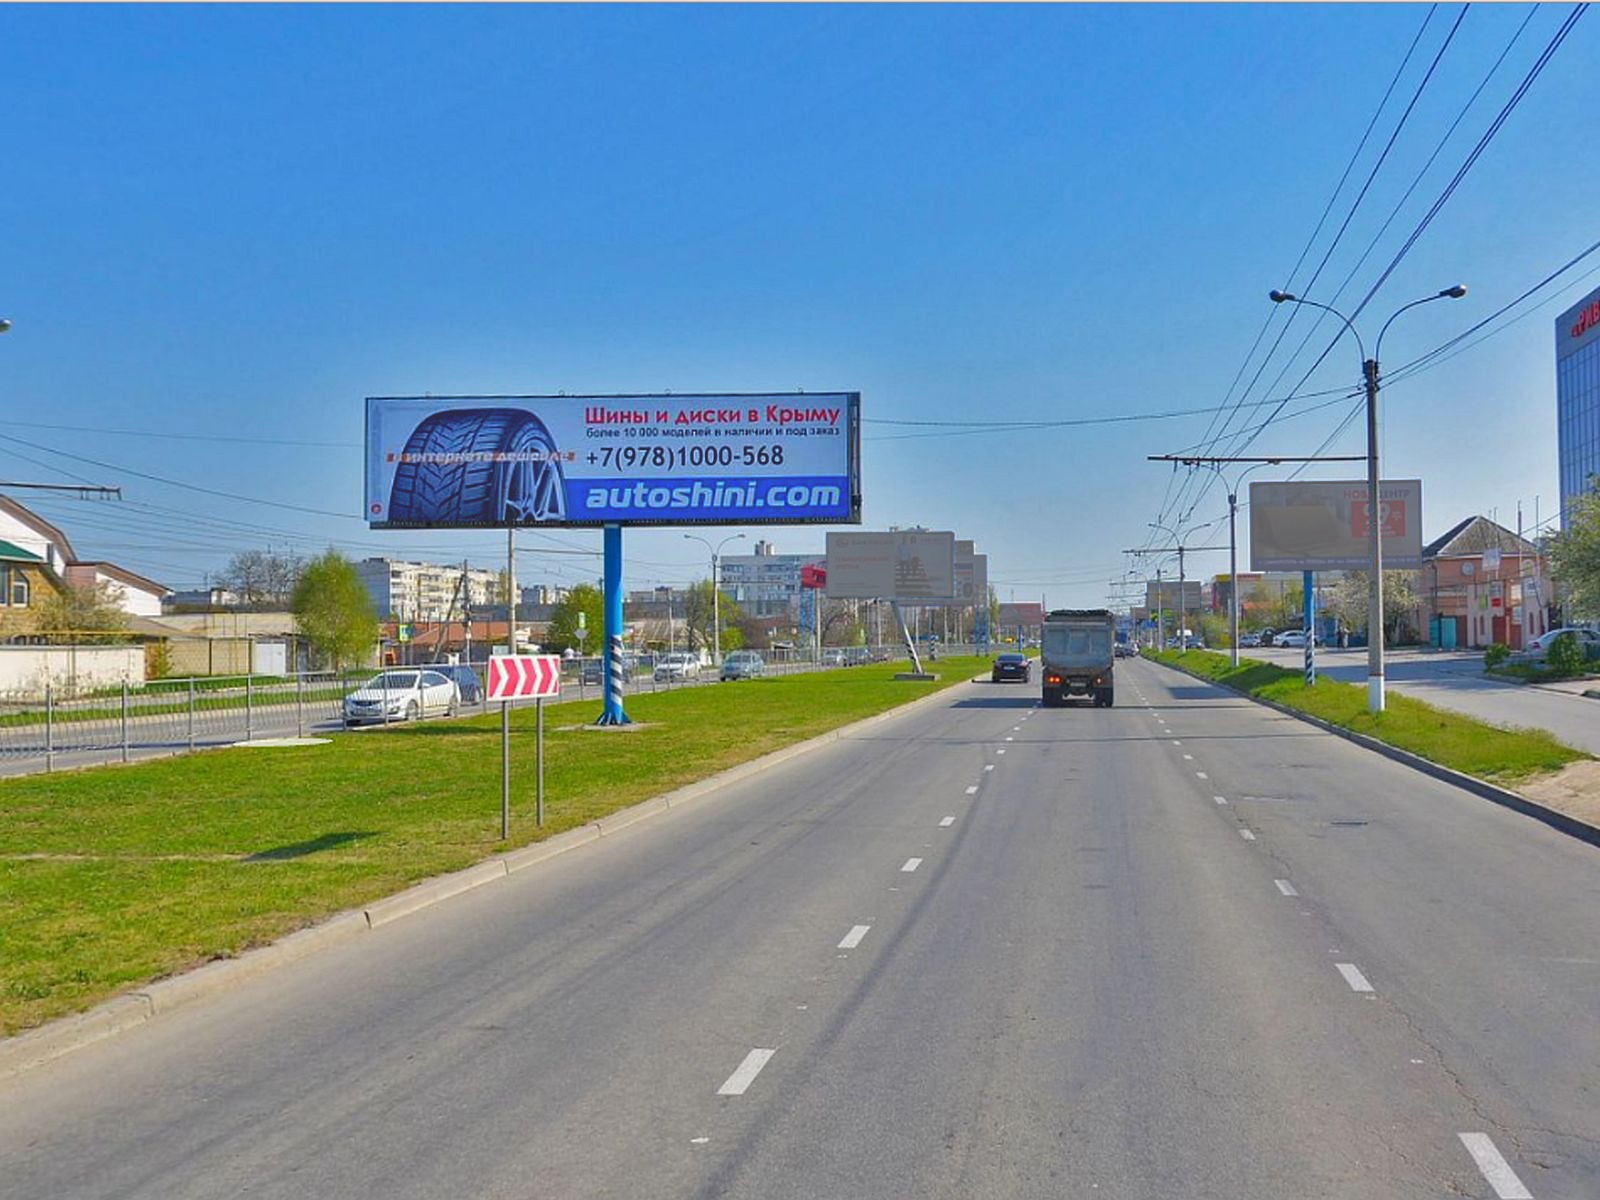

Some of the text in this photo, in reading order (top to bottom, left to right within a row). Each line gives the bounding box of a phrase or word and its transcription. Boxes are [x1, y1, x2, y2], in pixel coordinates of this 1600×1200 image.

[585, 405, 840, 426] Шины и диски в Крыму
[586, 427, 840, 439] более 10 000 моделей в наличии и под заказ
[586, 446, 784, 472] +7(978)1000-568
[586, 481, 840, 508] autoshini.com
